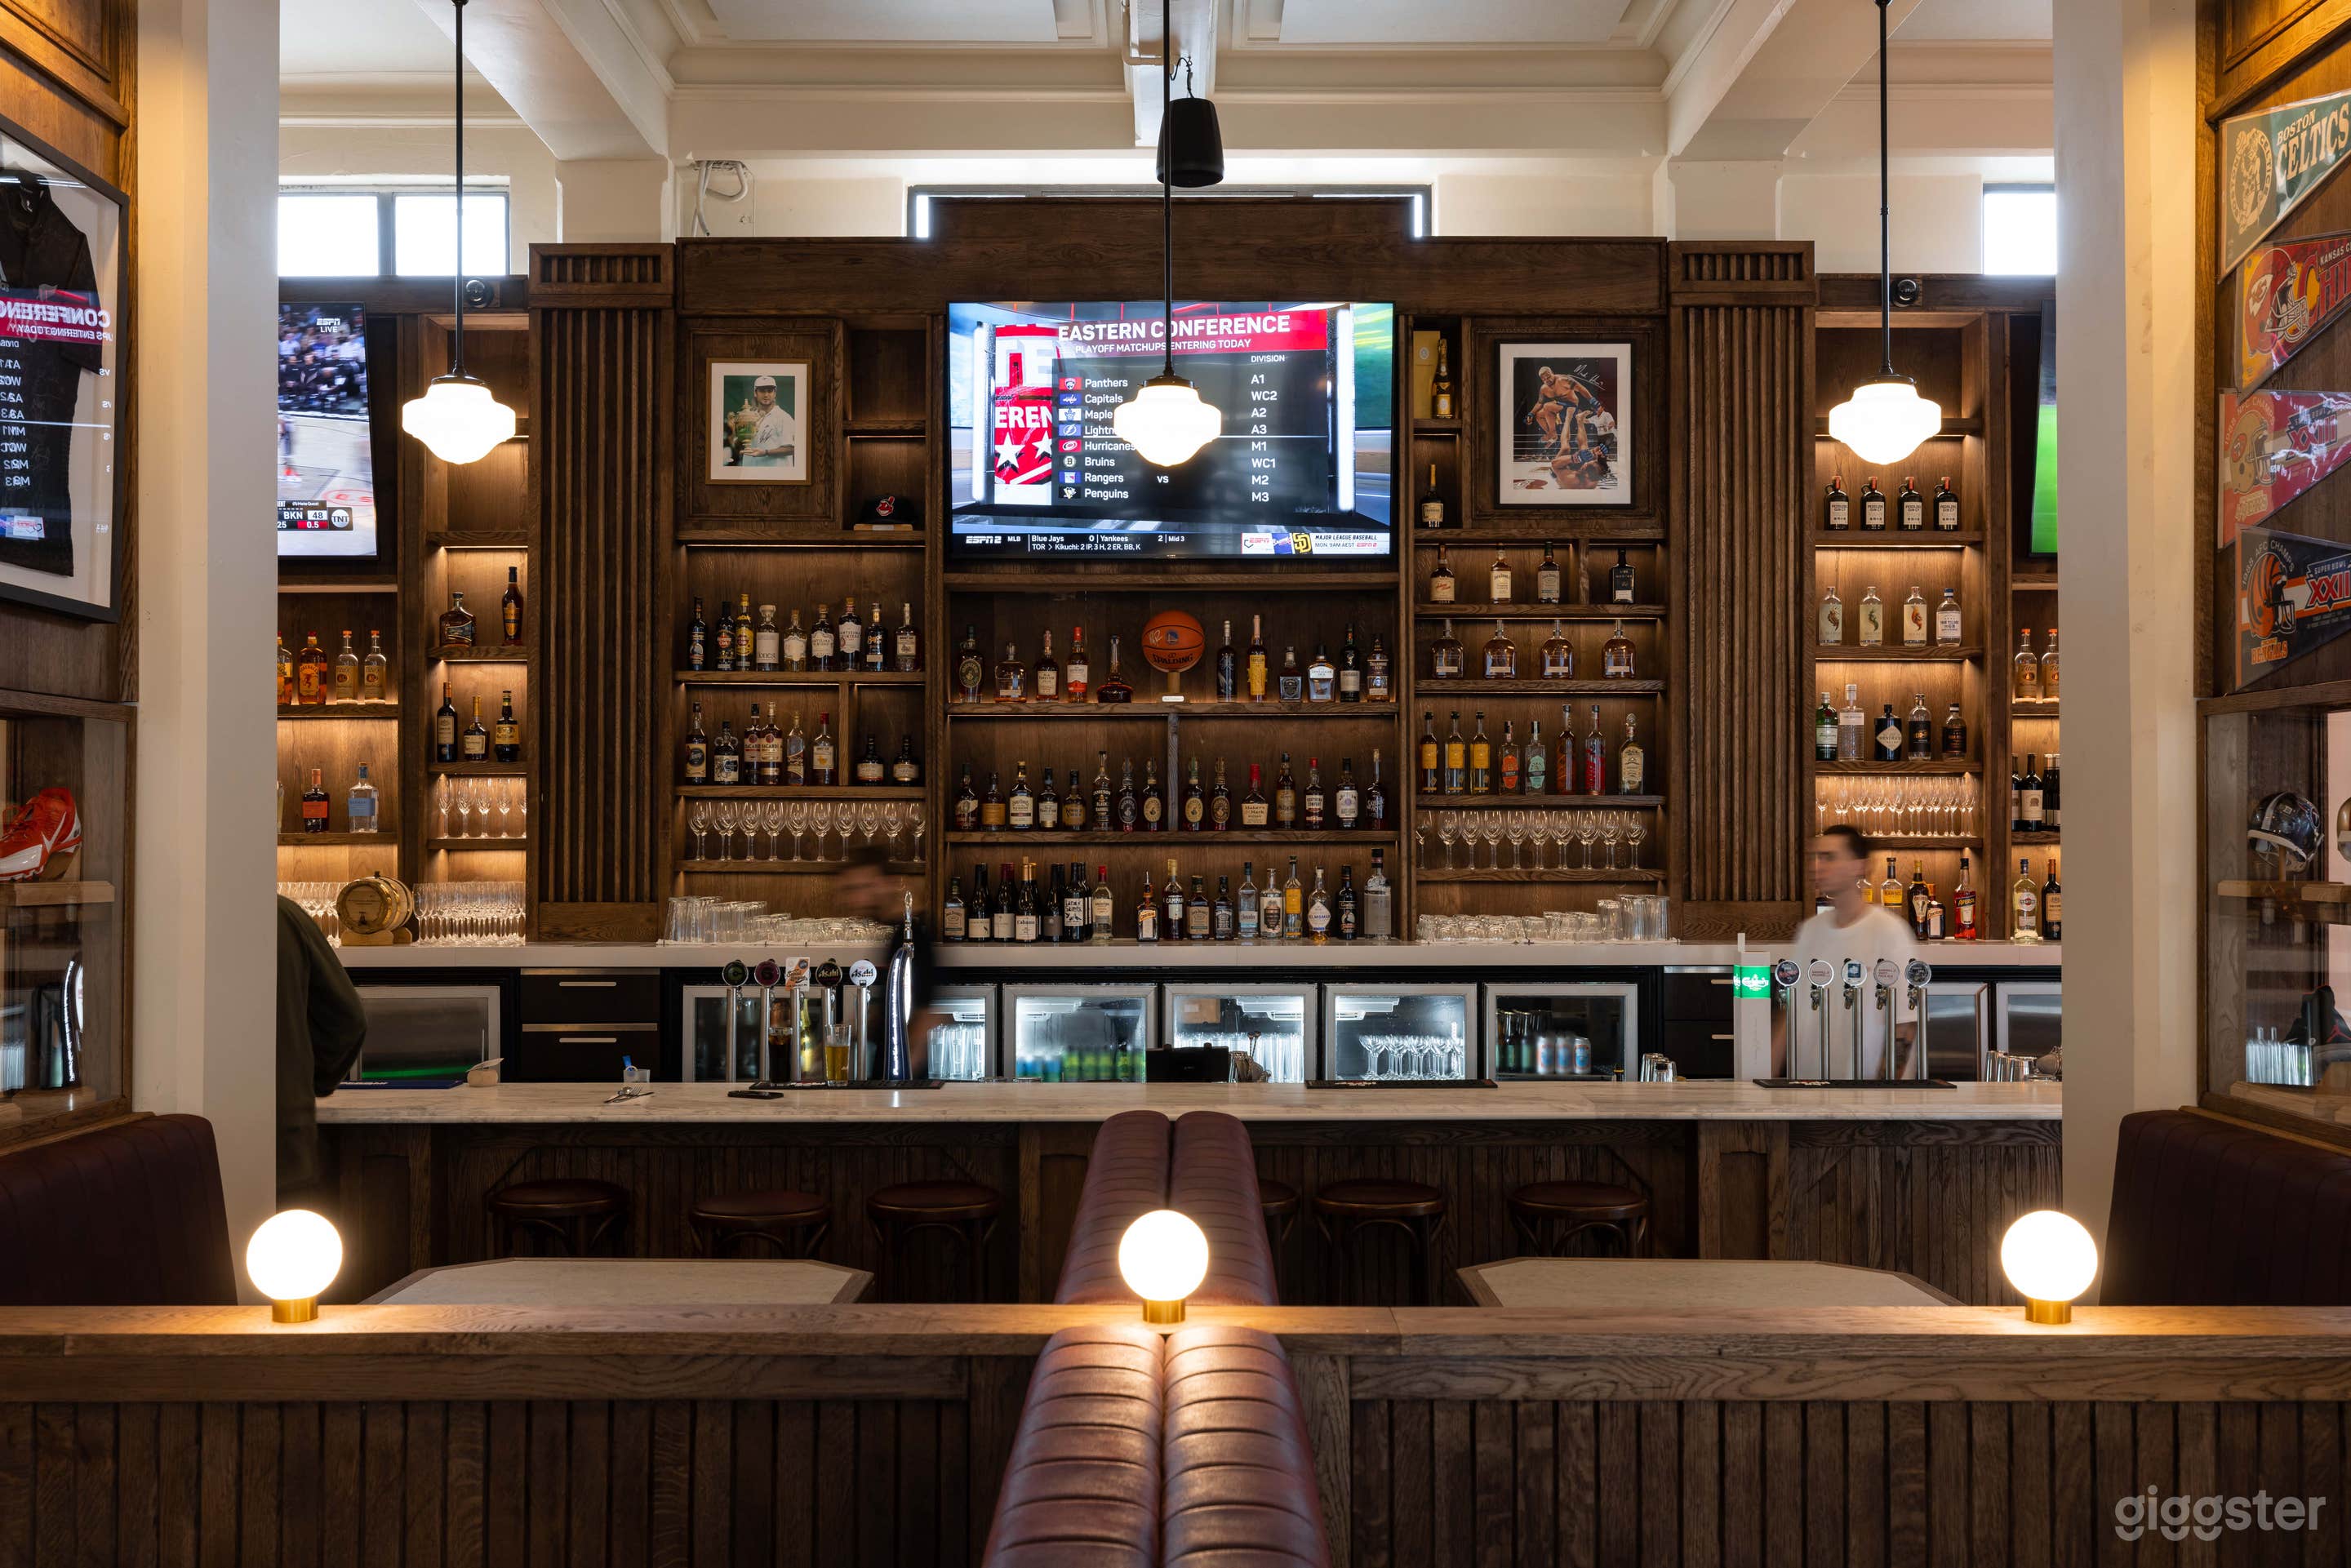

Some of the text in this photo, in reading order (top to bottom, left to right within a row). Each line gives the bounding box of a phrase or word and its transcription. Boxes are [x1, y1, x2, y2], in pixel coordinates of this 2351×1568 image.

[2278, 109, 2317, 144] BOSTON
[2278, 103, 2350, 185] CELTICS
[2320, 246, 2344, 265] KANSAS
[1059, 315, 1291, 341] EASTERN CONFERENCE
[1076, 339, 1251, 353] PLAYOFF MATCHUPS ENTERING TODAY
[1085, 379, 1128, 388] Panthers
[1251, 375, 1264, 384] A1
[1085, 395, 1123, 406] Capitals
[1251, 391, 1278, 401] WC2
[1085, 410, 1113, 421] Maple
[1251, 407, 1267, 418] A2
[1251, 424, 1267, 434] A3
[1085, 442, 1136, 451] Hurricanes
[1251, 442, 1267, 451] M1
[1085, 457, 1115, 466] Bruins
[1251, 458, 1276, 469] WC1
[1085, 473, 1169, 484] Rangers vs
[1251, 475, 1269, 485] M2
[1085, 489, 1128, 500] Penguins
[1251, 492, 1269, 502] M3
[283, 511, 303, 519] BKN
[1048, 535, 1064, 544] Jays
[2242, 540, 2295, 586] 1988 AFC CHAMPS
[2314, 560, 2347, 574] SUPER BOWL
[1153, 653, 1193, 664] SPALDING
[818, 969, 838, 978] Asahi
[851, 969, 873, 978] Asahi
